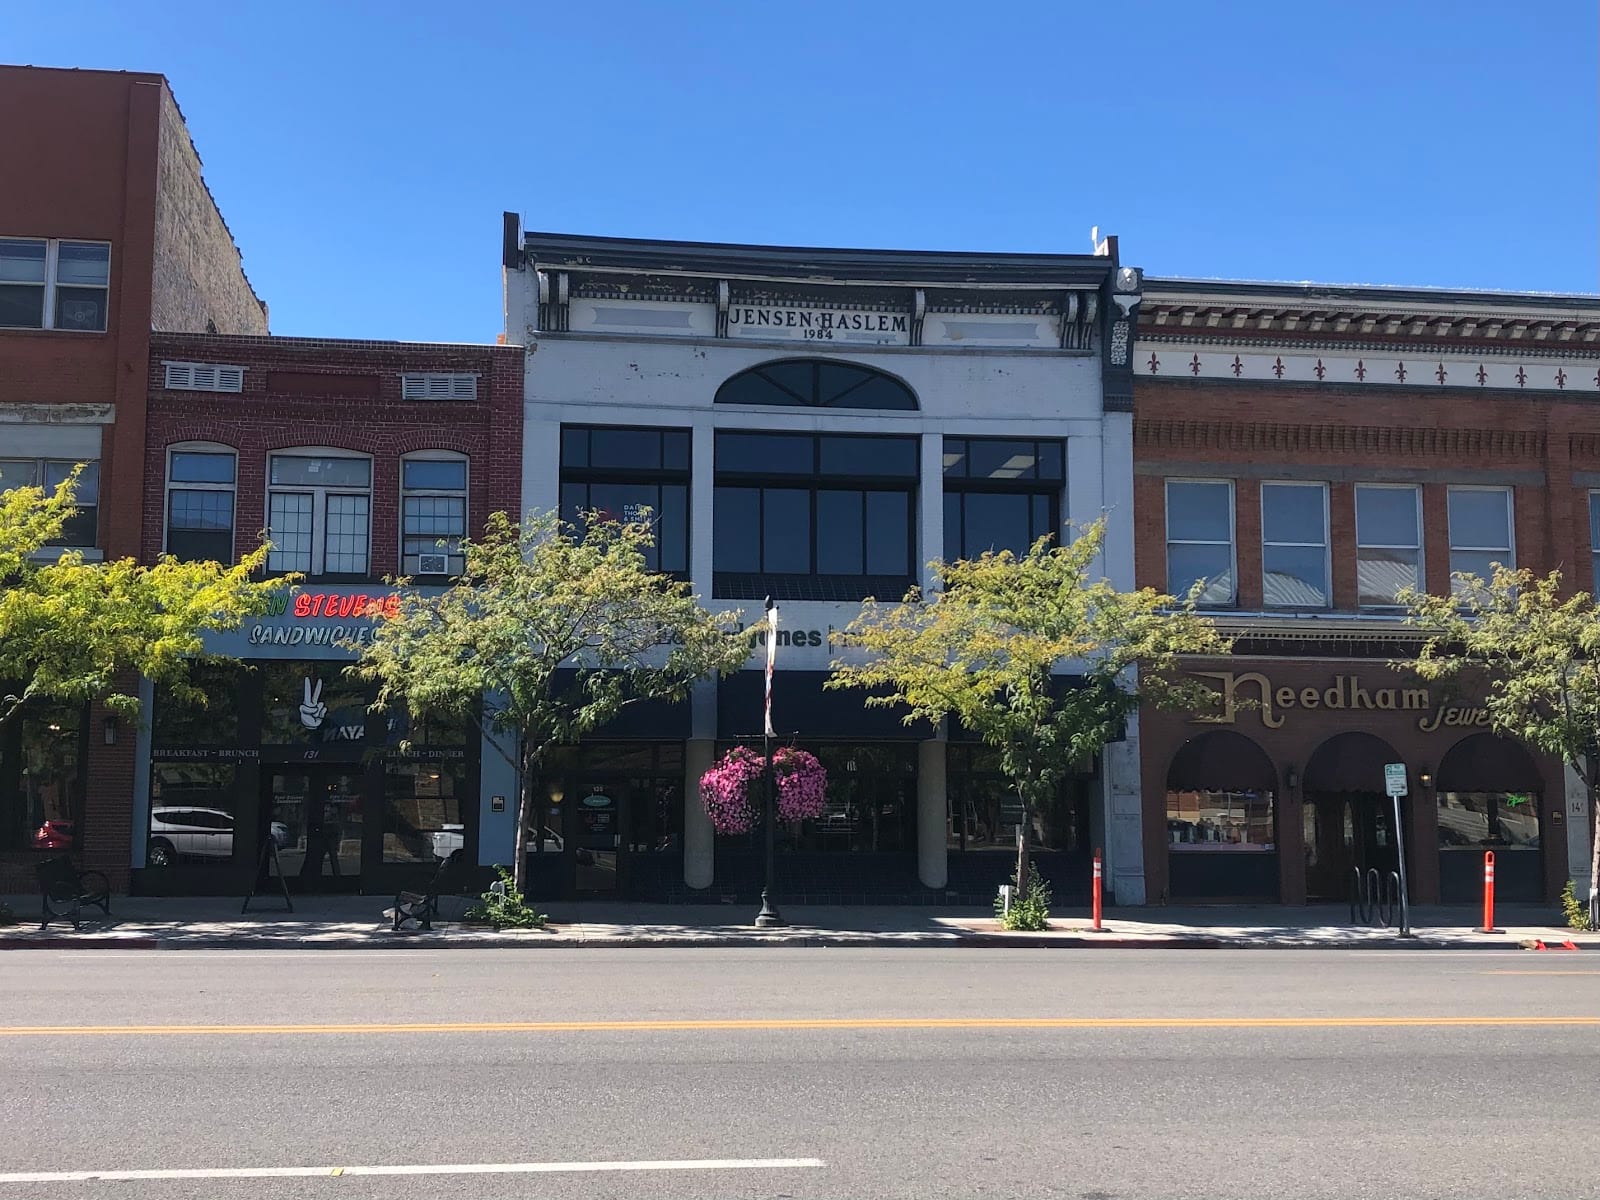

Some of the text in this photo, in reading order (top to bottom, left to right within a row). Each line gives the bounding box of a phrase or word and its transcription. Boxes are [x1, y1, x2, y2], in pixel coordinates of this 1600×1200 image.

[730, 309, 907, 332] JENSEN HASLEM
[804, 329, 833, 340] 1984
[294, 593, 400, 618] STEVENS
[1187, 672, 1430, 729] Needham
[153, 749, 209, 758] BREAKFAST
[218, 749, 260, 758] BRUNCH
[303, 750, 319, 759] 131
